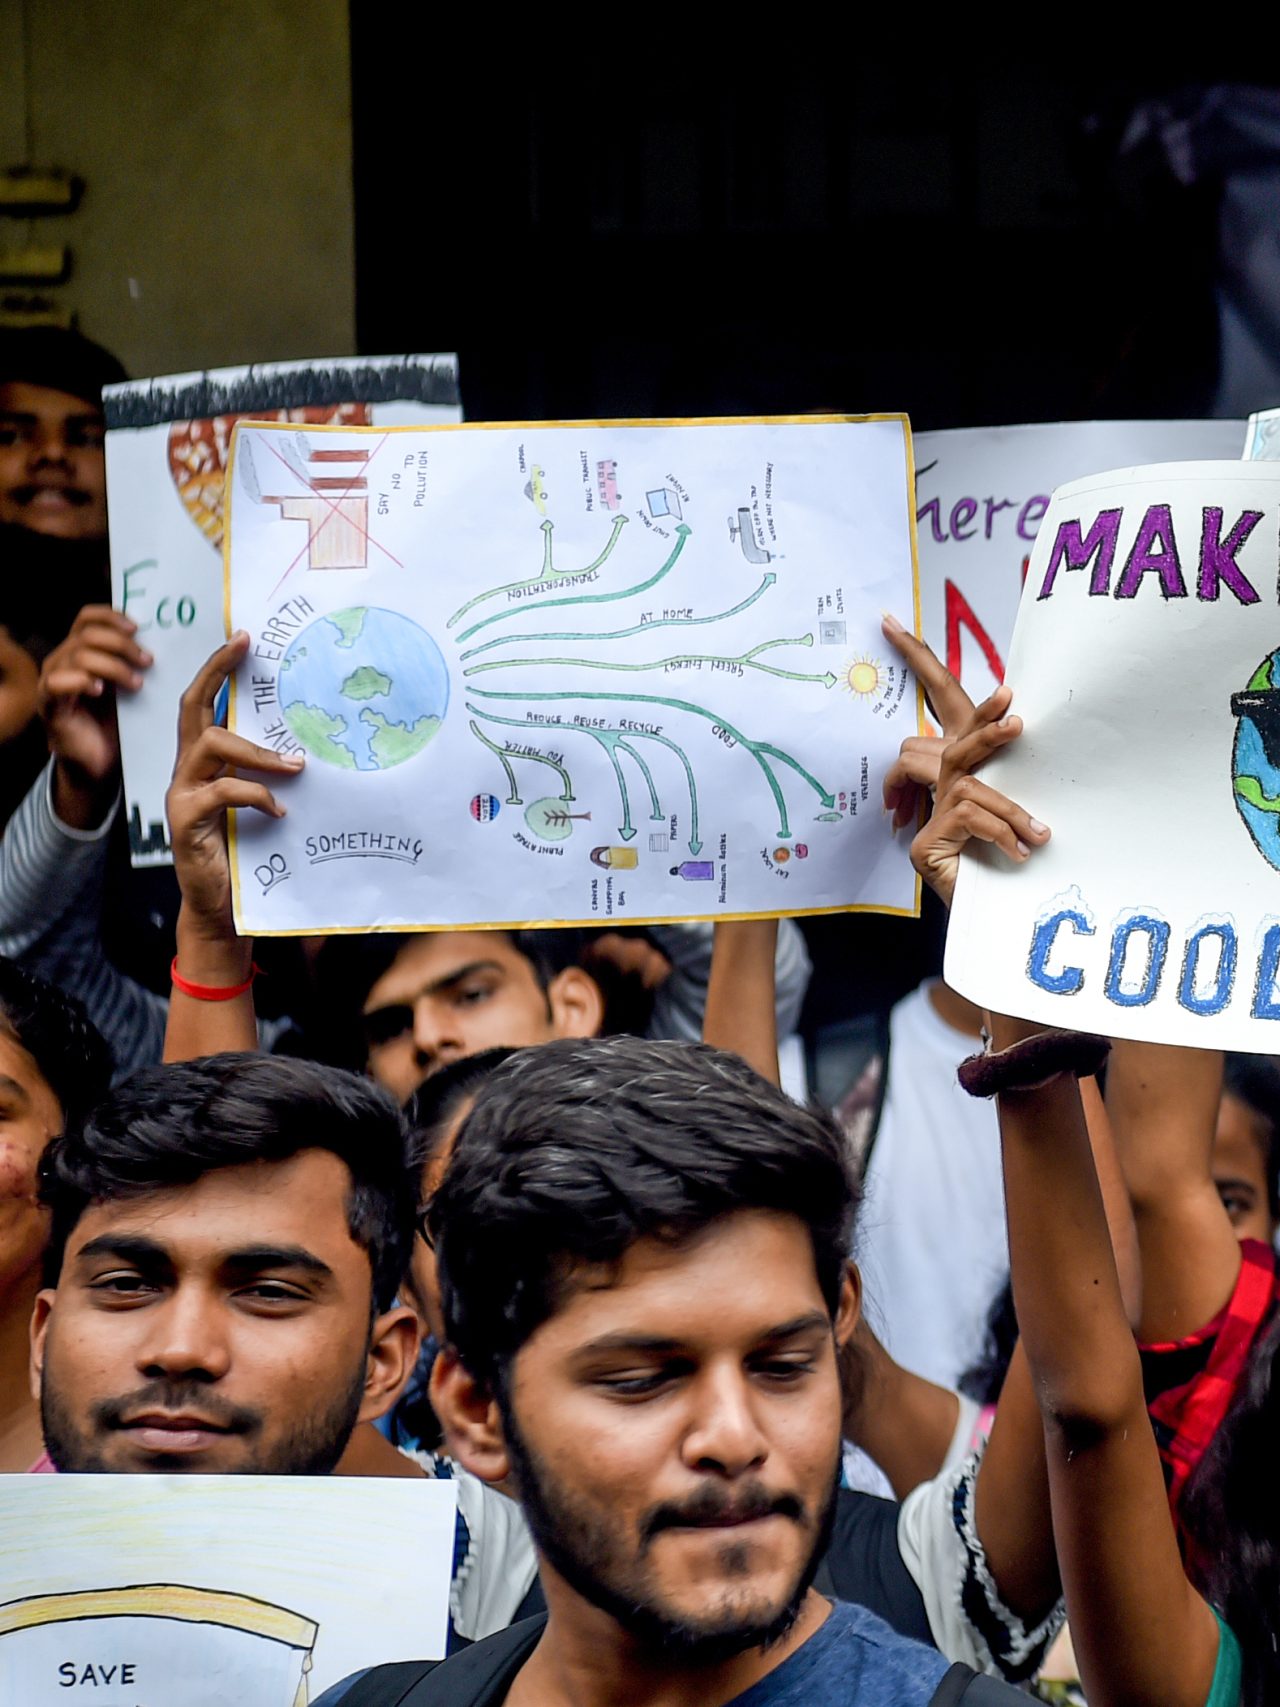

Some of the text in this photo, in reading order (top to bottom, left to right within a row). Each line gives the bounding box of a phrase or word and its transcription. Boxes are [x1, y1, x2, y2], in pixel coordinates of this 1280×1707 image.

[404, 454, 415, 469] TO
[391, 473, 402, 490] NO
[413, 450, 429, 508] POLLUTION
[377, 492, 390, 515] SAY
[507, 571, 600, 602] TRANSPORTATION
[254, 594, 315, 661] EARTH
[640, 608, 693, 625] AT HOME
[664, 659, 744, 678] GREEN ENERGY
[251, 675, 277, 714] THE
[619, 719, 664, 736] RECYCLE
[711, 724, 738, 748] FOOD
[480, 798, 488, 821] VOTE
[669, 814, 678, 840] PAPERS
[254, 832, 423, 887] DO SOMETHING
[58, 1661, 137, 1688] SAVE
